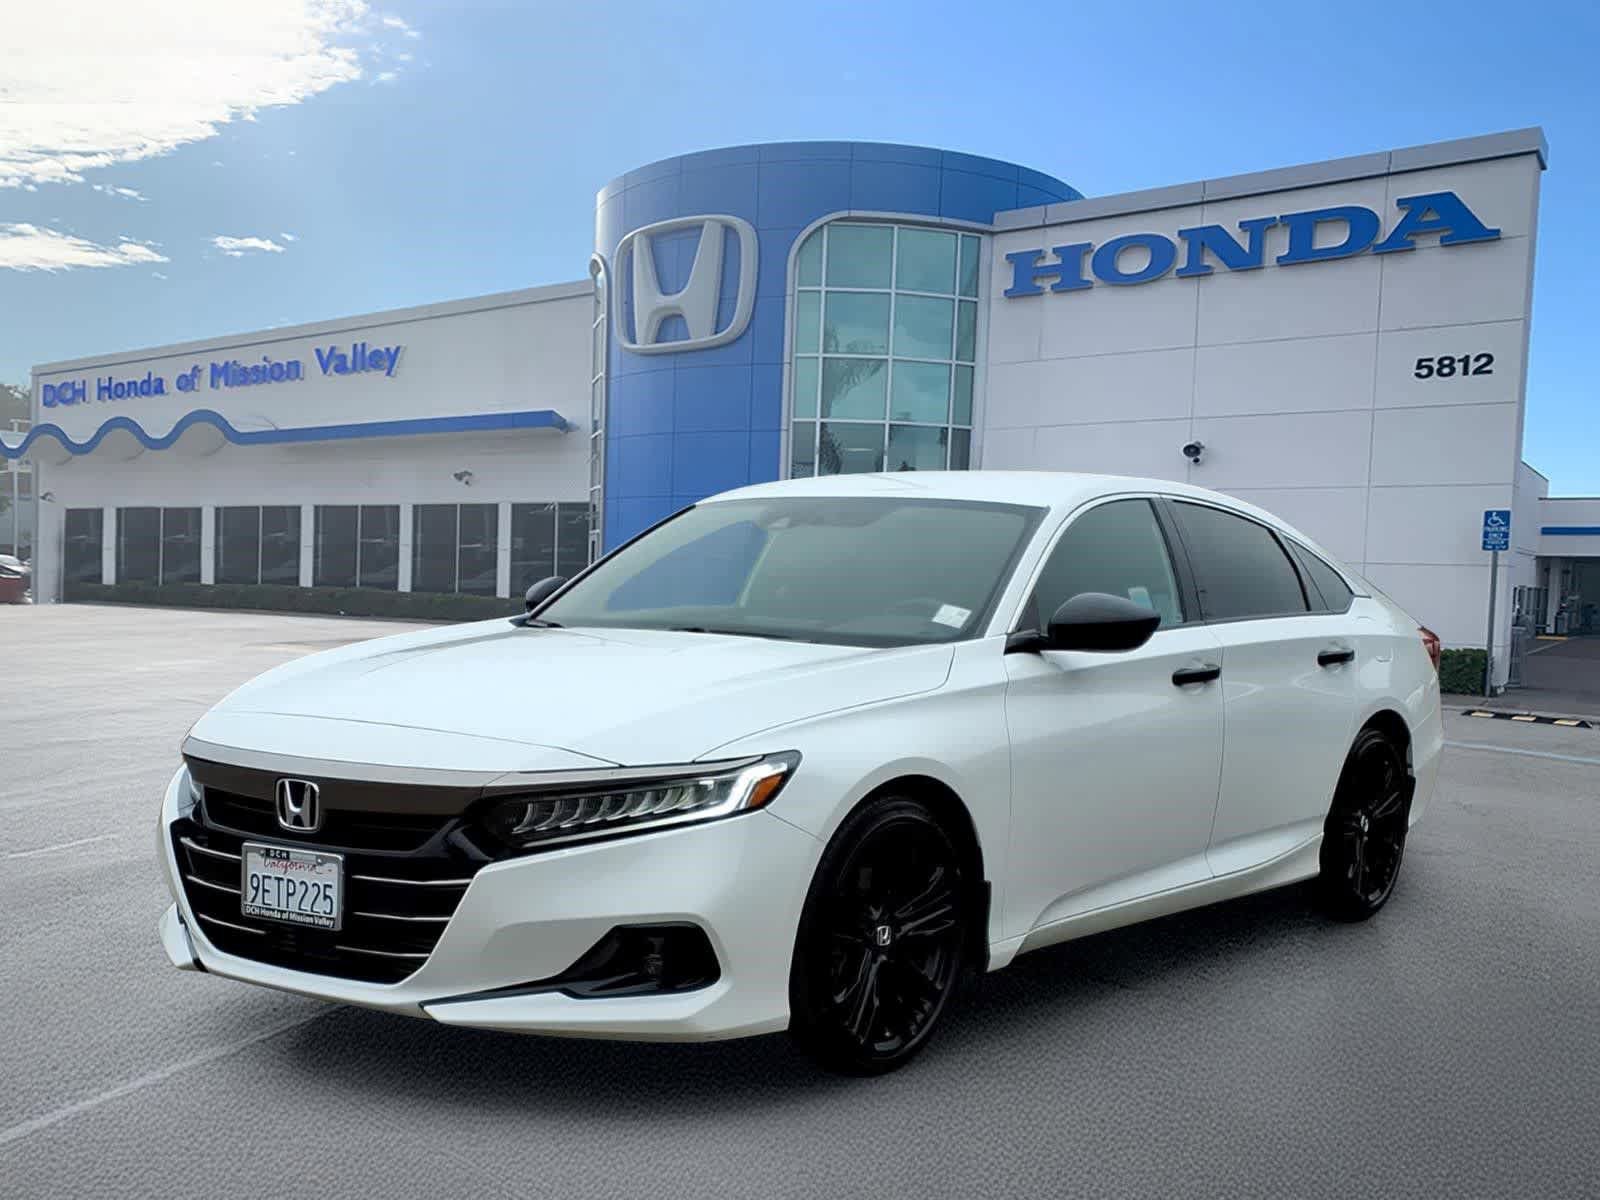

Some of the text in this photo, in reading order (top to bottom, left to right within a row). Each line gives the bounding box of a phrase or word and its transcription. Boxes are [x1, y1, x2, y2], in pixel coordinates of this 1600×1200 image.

[1004, 190, 1501, 298] HONDA
[42, 343, 401, 408] DCH Honda of Mission Valley
[1414, 353, 1495, 380] 5812
[250, 873, 334, 915] 9ETP225
